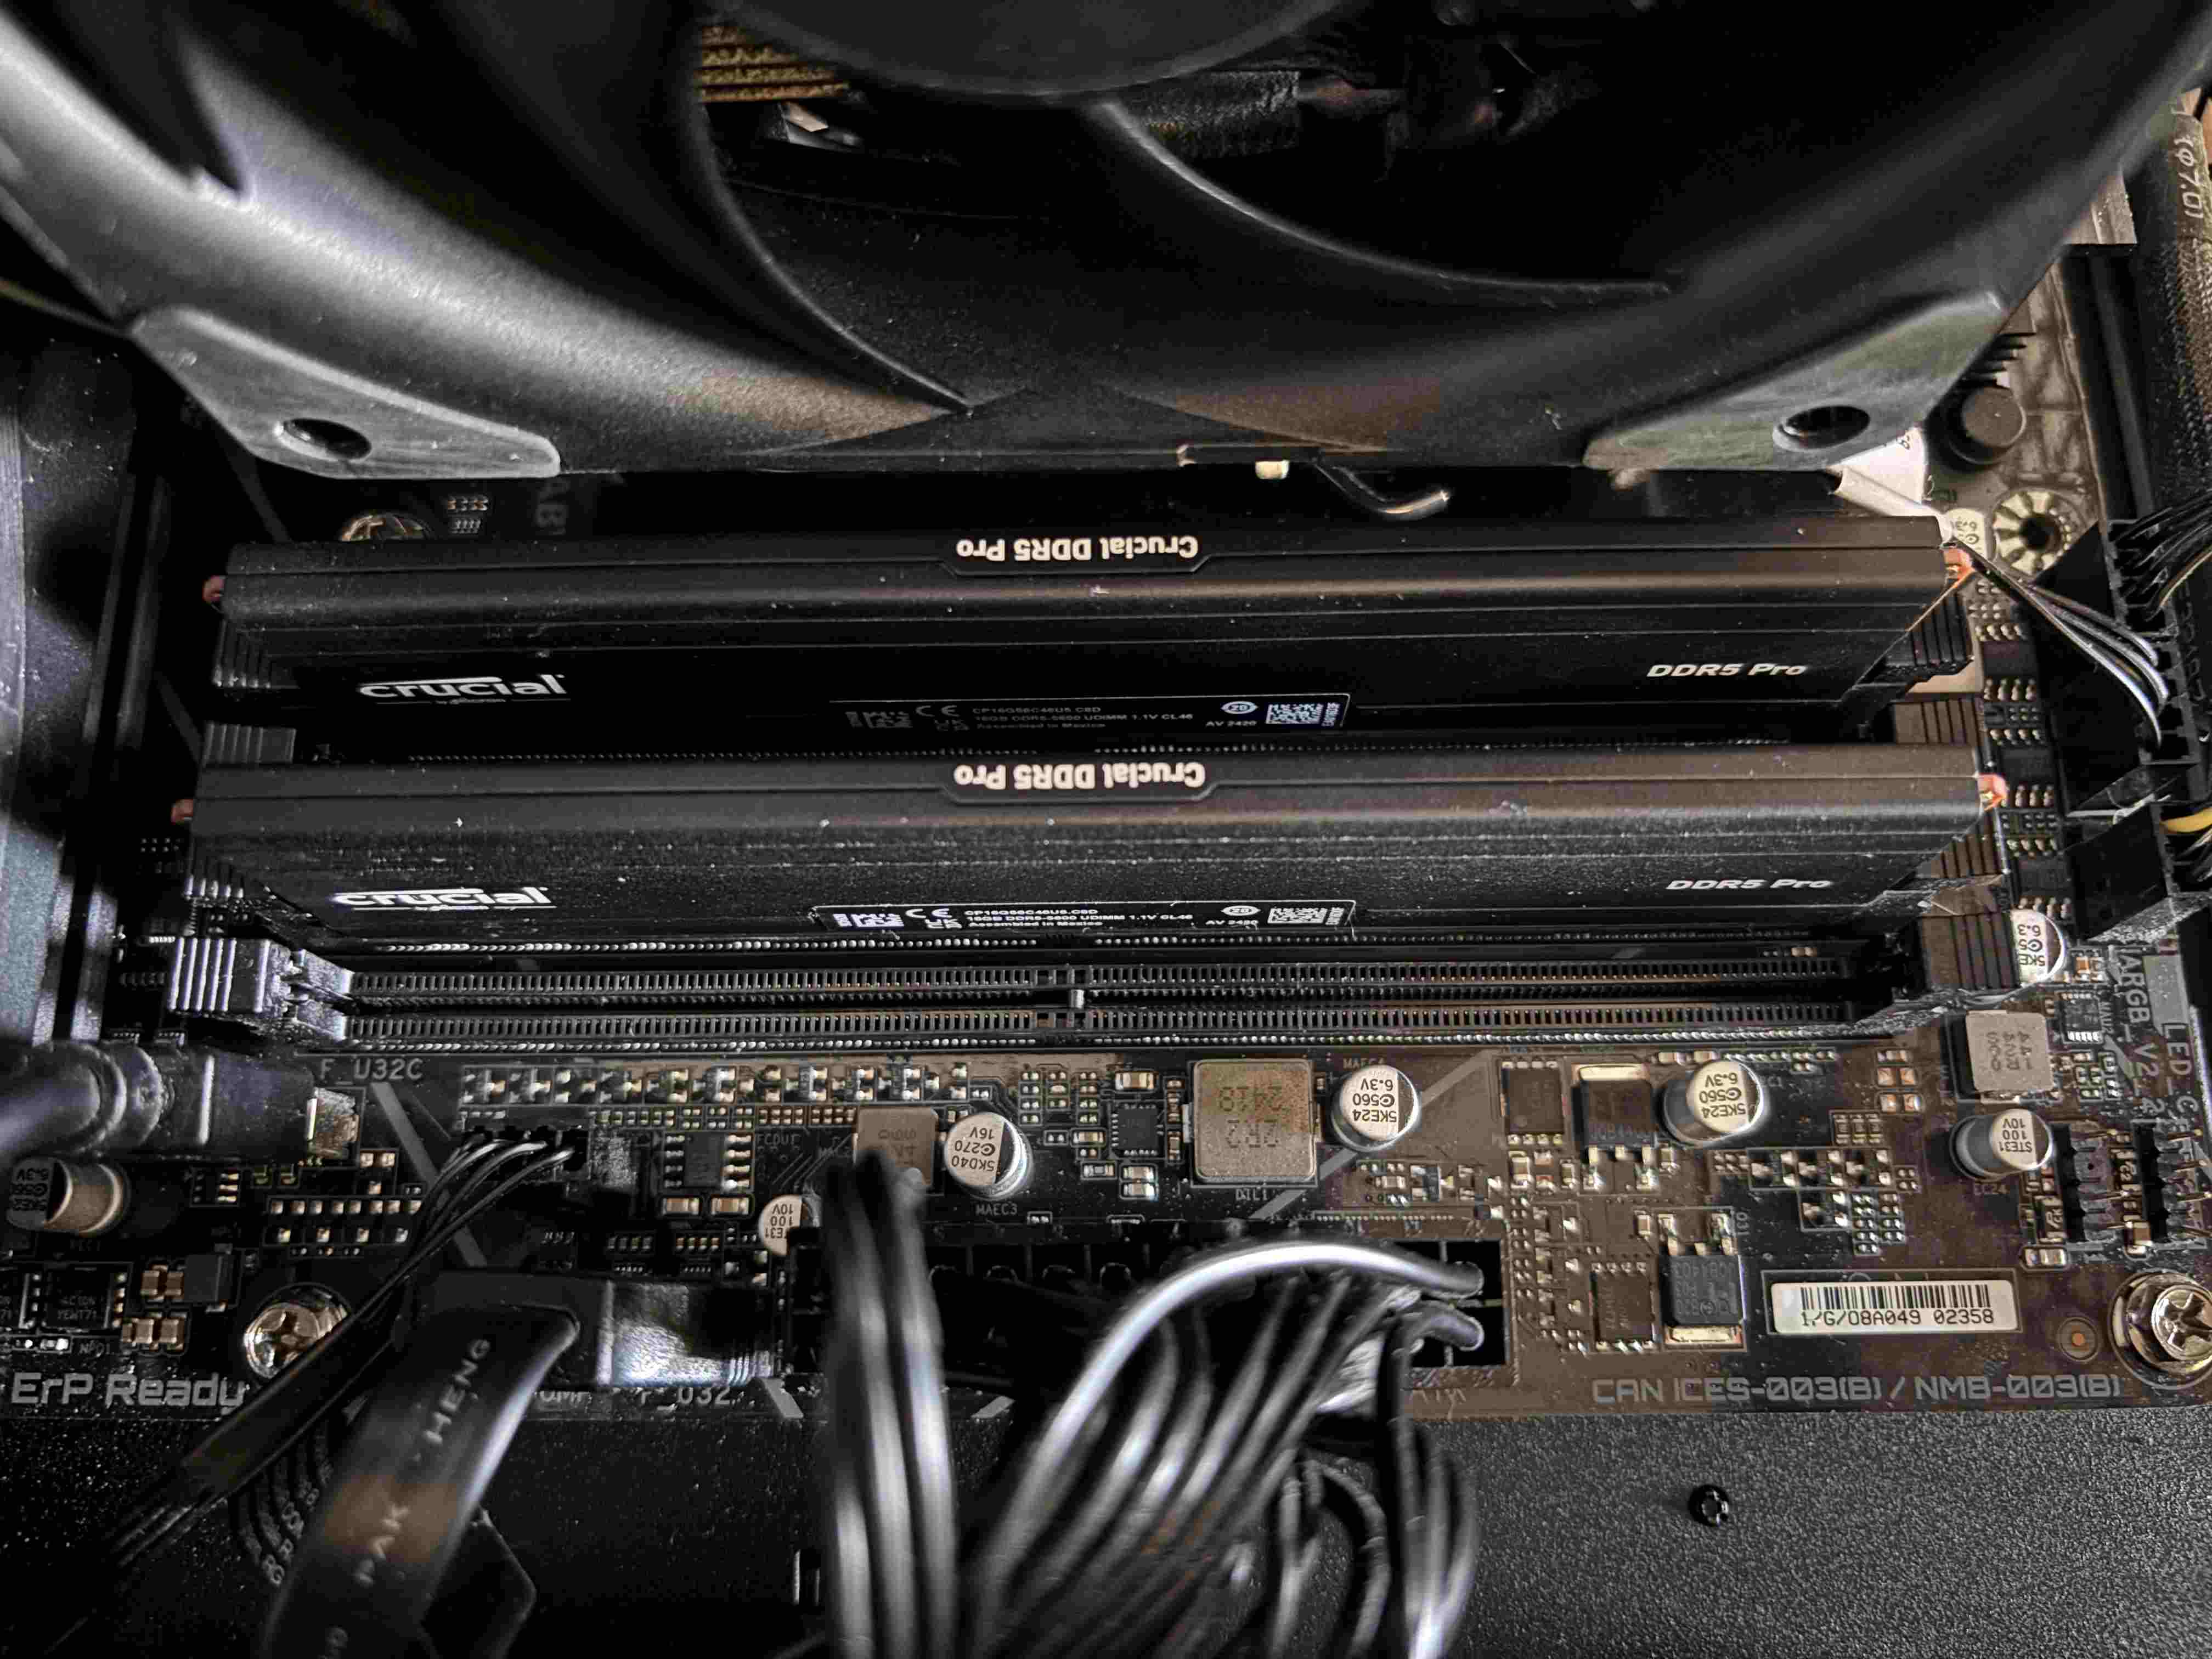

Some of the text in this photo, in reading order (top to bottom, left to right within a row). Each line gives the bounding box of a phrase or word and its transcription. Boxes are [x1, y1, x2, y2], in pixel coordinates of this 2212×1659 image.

[956, 535, 1199, 562] Crucial DDR5 Pro
[1646, 662, 1809, 678] DDR5 Pro
[953, 761, 1205, 790] Crucial DDR5 Pro
[1665, 879, 1836, 890] DDR5 Pro
[2017, 924, 2041, 938] 6.3
[1359, 1077, 1393, 1092] 6.3V
[1703, 1071, 1739, 1088] 6.3V
[1352, 1109, 1397, 1123] 5KE24
[1701, 1103, 1747, 1118] 5KE24
[2002, 1118, 2027, 1130] 10V
[970, 1126, 995, 1141] 16V
[2002, 1130, 2028, 1141] 100
[1999, 1141, 2033, 1153] STE31
[772, 1204, 793, 1214] 10V
[770, 1216, 794, 1226] 100
[765, 1227, 788, 1239] TE31
[1933, 1308, 1995, 1325] 02358
[11, 1372, 249, 1415] ErP Ready
[1591, 1377, 1663, 1405] CAN
[1673, 1375, 1883, 1405] ICES-003(B)
[1914, 1373, 2121, 1402] NMB-003(B)
